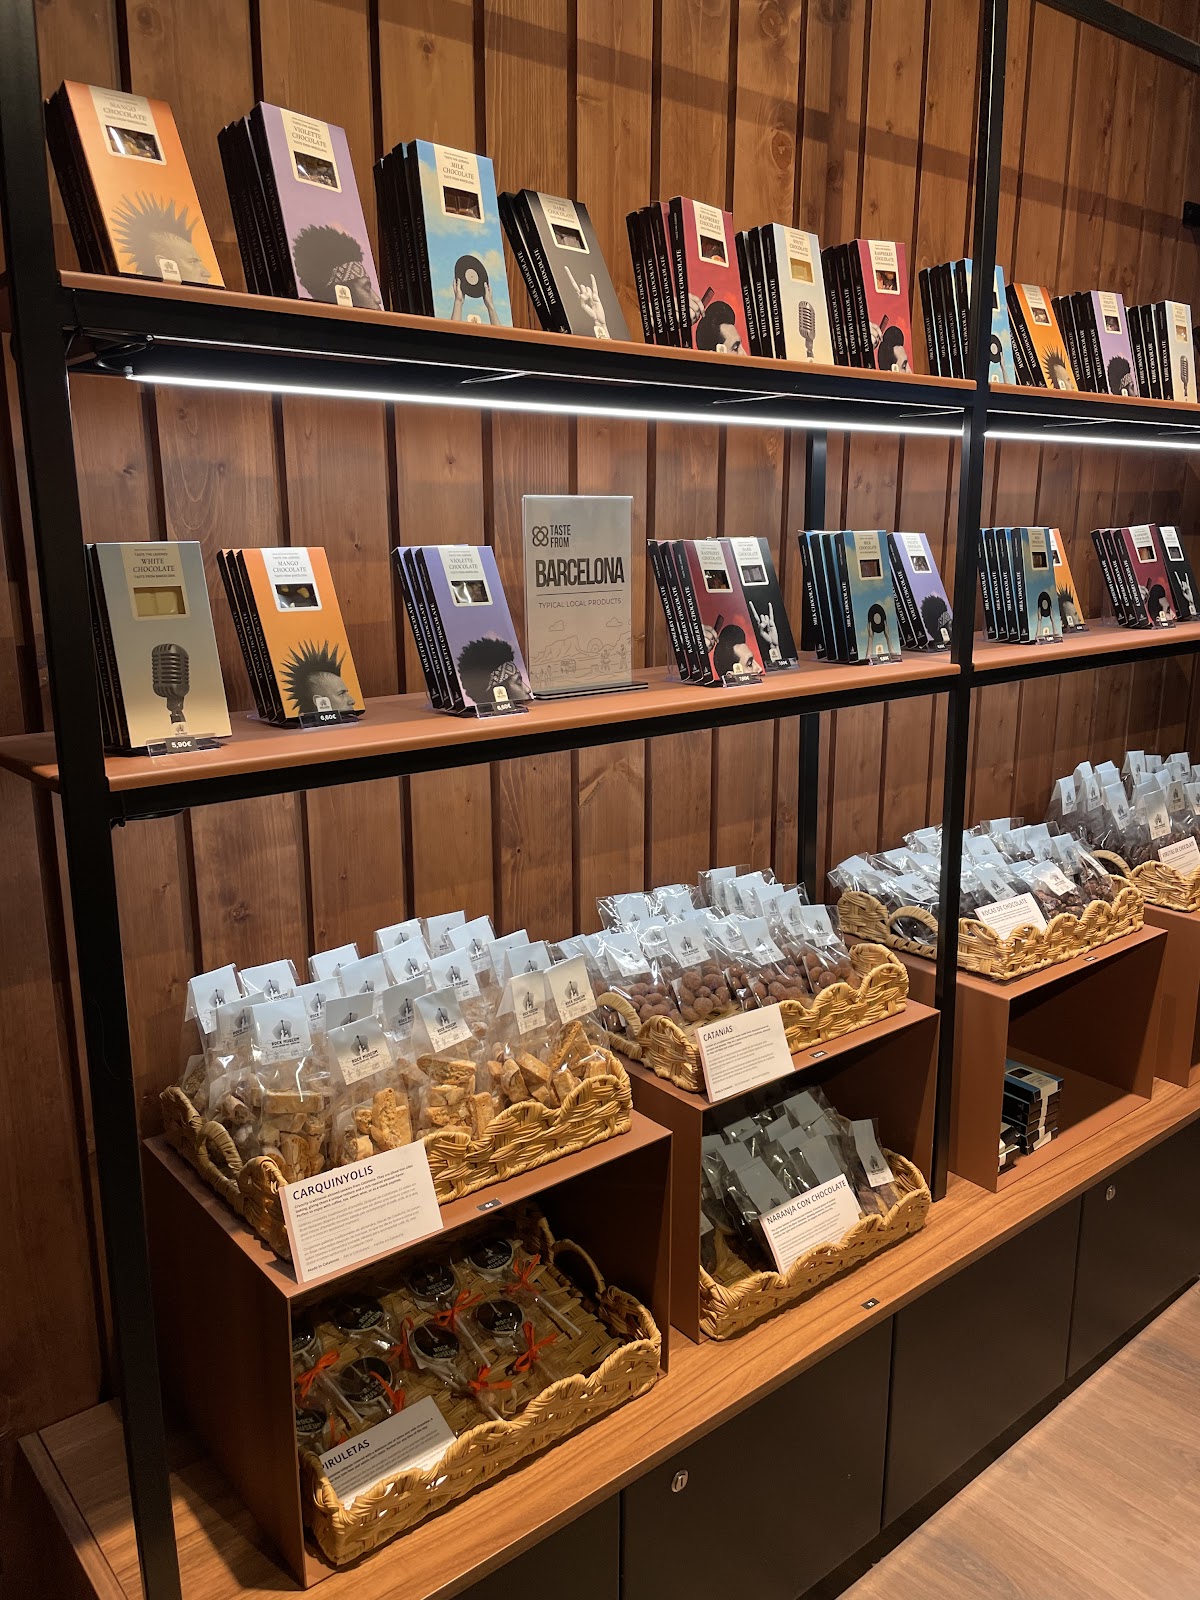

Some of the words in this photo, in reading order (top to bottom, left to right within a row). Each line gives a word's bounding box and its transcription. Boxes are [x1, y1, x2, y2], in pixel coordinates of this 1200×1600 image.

[103, 108, 147, 121] CHOCOLATE
[292, 132, 327, 147] CHOCOLATE
[294, 125, 322, 140] VIOLETTE
[443, 167, 474, 179] CHOCOLATE
[452, 162, 464, 171] MILK
[518, 251, 535, 288] CHOCOLATE
[534, 248, 550, 286] CHOCOLATE
[648, 259, 658, 296] CHOCOLATE
[660, 256, 669, 294] CHOCOLATE
[676, 250, 684, 289] CHOCOLATE
[531, 291, 541, 306] DARK
[546, 289, 556, 305] DARK
[744, 286, 752, 321] CHOCOLATE
[831, 290, 839, 323] CHOCOLATE
[844, 288, 852, 322] CHOCOLATE
[857, 285, 865, 319] CHOCOLATE
[654, 298, 663, 333] RASPBERRY
[666, 296, 674, 331] RASPBERRY
[835, 324, 843, 354] RASPBERRY
[848, 323, 856, 354] RASPBERRY
[550, 525, 571, 536] TASTE
[550, 537, 569, 548] FROM
[536, 557, 624, 587] BARCELONA
[588, 598, 621, 606] PRODUCTS
[660, 586, 672, 619] CHOCOLATE
[672, 586, 684, 620] CHOCOLATE
[685, 587, 697, 621] CHOCOLATE
[807, 582, 816, 612] CHOCOLATE
[407, 602, 421, 640] CHOCOLATE
[419, 602, 432, 640] CHOCOLATE
[430, 603, 444, 641] CHOCOLATE
[668, 621, 680, 652] RASPBERRY
[680, 622, 693, 653] RASPBERRY
[693, 623, 705, 655] RASPBERRY
[417, 641, 430, 673] VIOLETTE
[428, 642, 441, 674] VIOLETTE
[440, 643, 453, 676] VIOLETTE
[1003, 898, 1028, 910] CHOCOLATE
[702, 1025, 733, 1042] CATANIAS
[362, 1050, 378, 1059] MUSEUM
[292, 1165, 374, 1201] CARQUINYOLIS
[767, 1204, 796, 1224] NARANJA
[797, 1198, 811, 1211] CON
[811, 1180, 847, 1206] CHOCOLATE
[322, 1439, 371, 1471] IRULETAS
